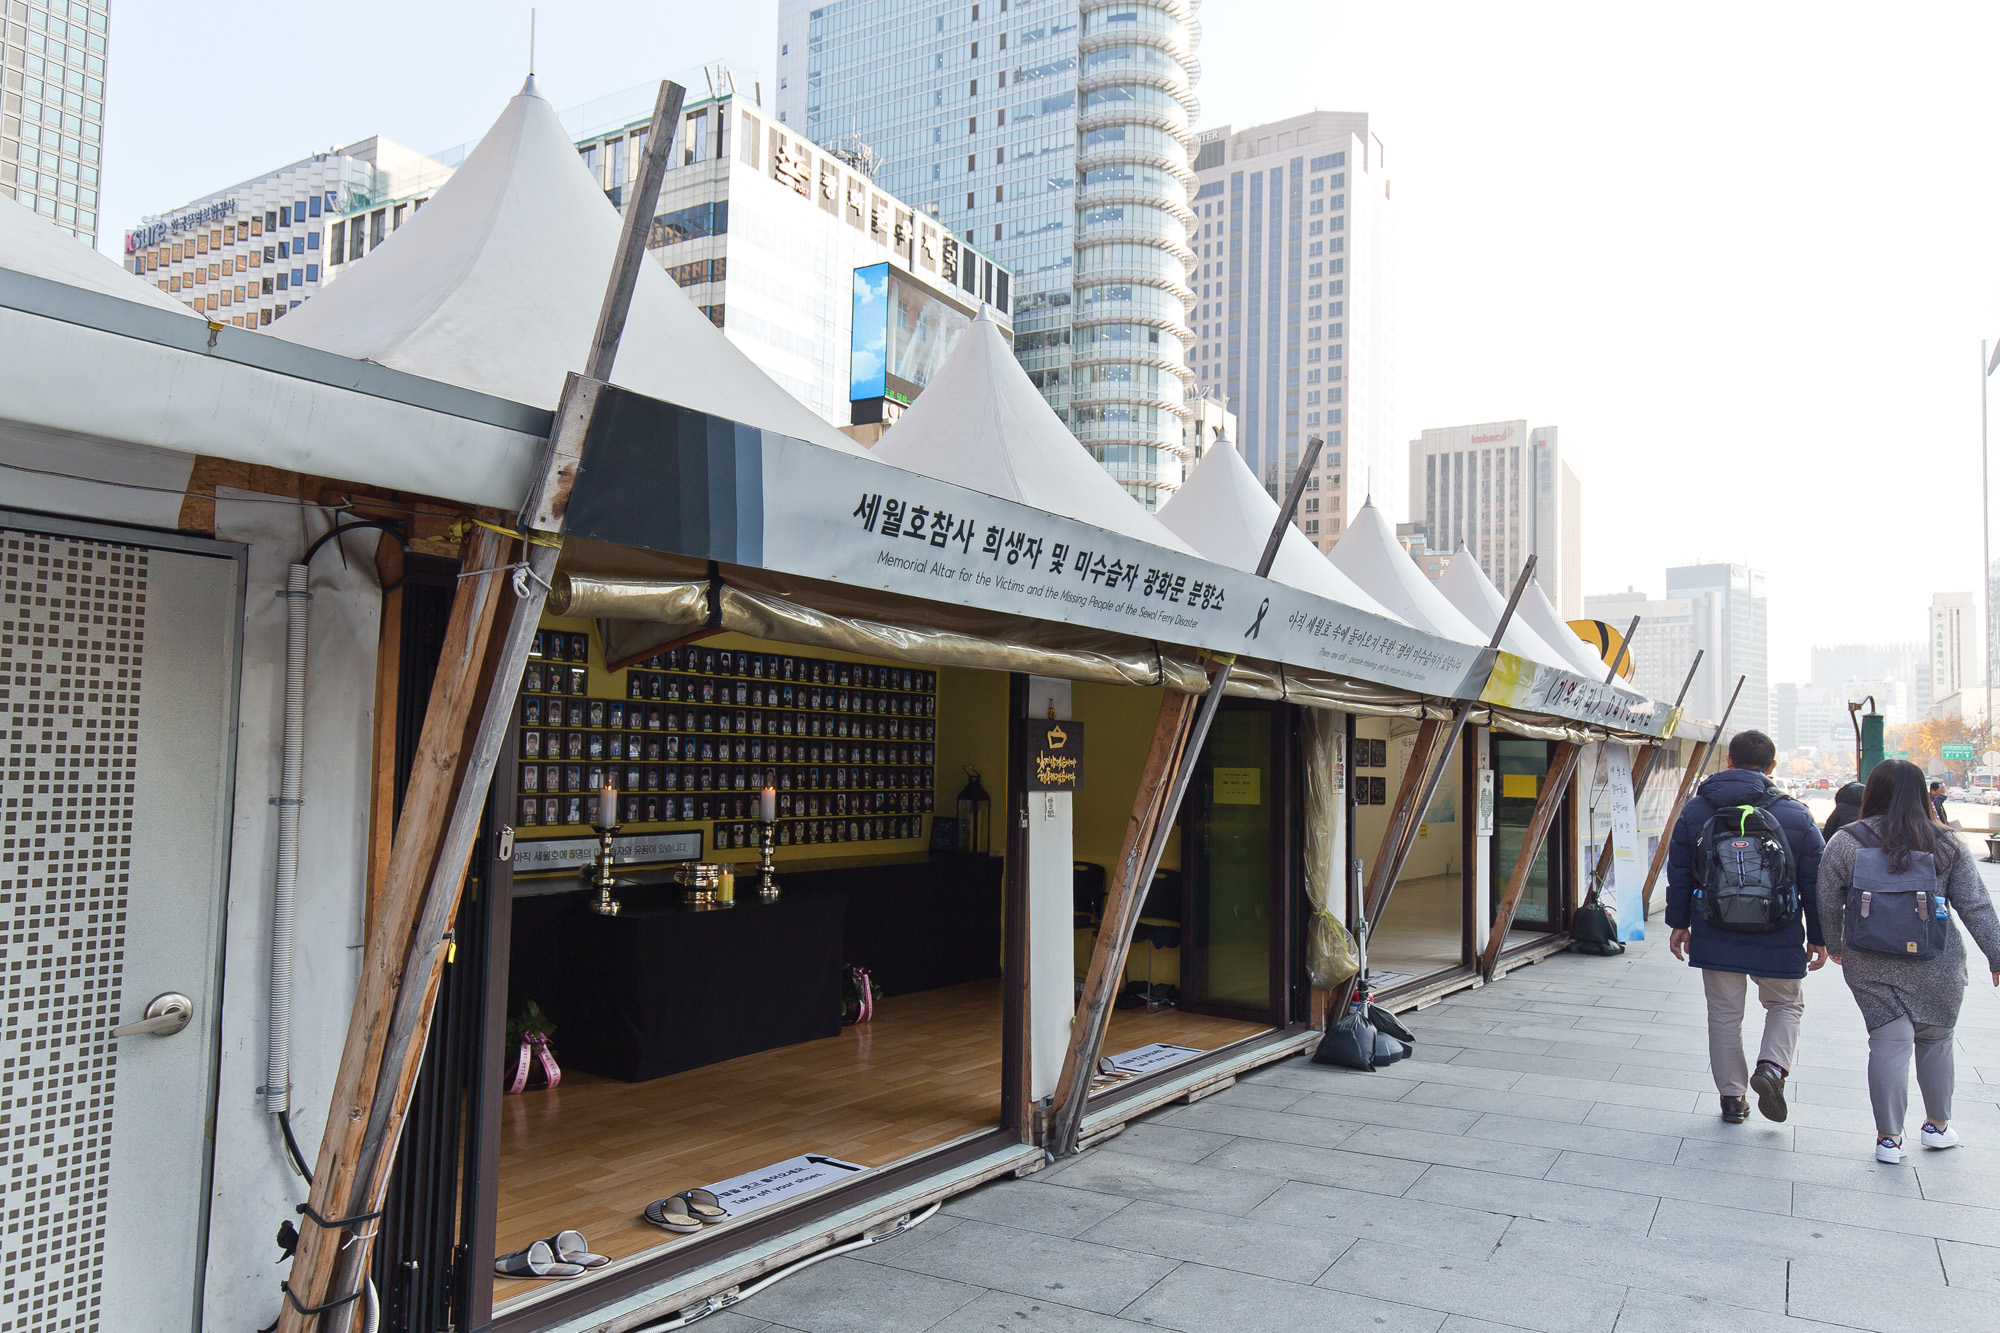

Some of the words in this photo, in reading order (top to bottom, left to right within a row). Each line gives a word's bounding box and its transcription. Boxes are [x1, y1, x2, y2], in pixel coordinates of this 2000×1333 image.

[1471, 432, 1507, 444] kobaco
[853, 493, 975, 554] 세월호참사
[982, 525, 1043, 570] 희생자
[1049, 543, 1069, 575] 및
[1074, 551, 1139, 592] 미수습자
[1143, 568, 1186, 602] 광화문
[1187, 580, 1225, 610] 분향소
[877, 550, 928, 573] Memorial
[930, 562, 956, 579] Altar
[958, 568, 974, 582] for
[975, 572, 992, 586] the
[995, 575, 1025, 593] Victims
[1026, 584, 1044, 597] and
[1045, 586, 1059, 600] the
[1060, 589, 1087, 608] Missing
[1088, 595, 1114, 611] People
[1115, 602, 1124, 613] of
[1125, 604, 1137, 616] the
[1138, 607, 1158, 621] Sewol
[1157, 610, 1175, 625] Ferry
[1175, 614, 1199, 629] Disaster
[1288, 611, 1307, 632] 아직
[1306, 616, 1333, 637] 세월호
[1333, 624, 1351, 642] 속에
[1350, 629, 1381, 651] 돌아오지
[1319, 647, 1330, 658] There
[514, 851, 531, 862] 아직
[534, 849, 568, 861] 세월호에
[569, 848, 592, 859] 5명의
[594, 845, 633, 858] 미습자와
[634, 845, 657, 856] 유품이
[658, 843, 688, 854] 있습니다.
[730, 1195, 757, 1205] Take
[758, 1189, 773, 1197] off
[773, 1182, 794, 1191] your
